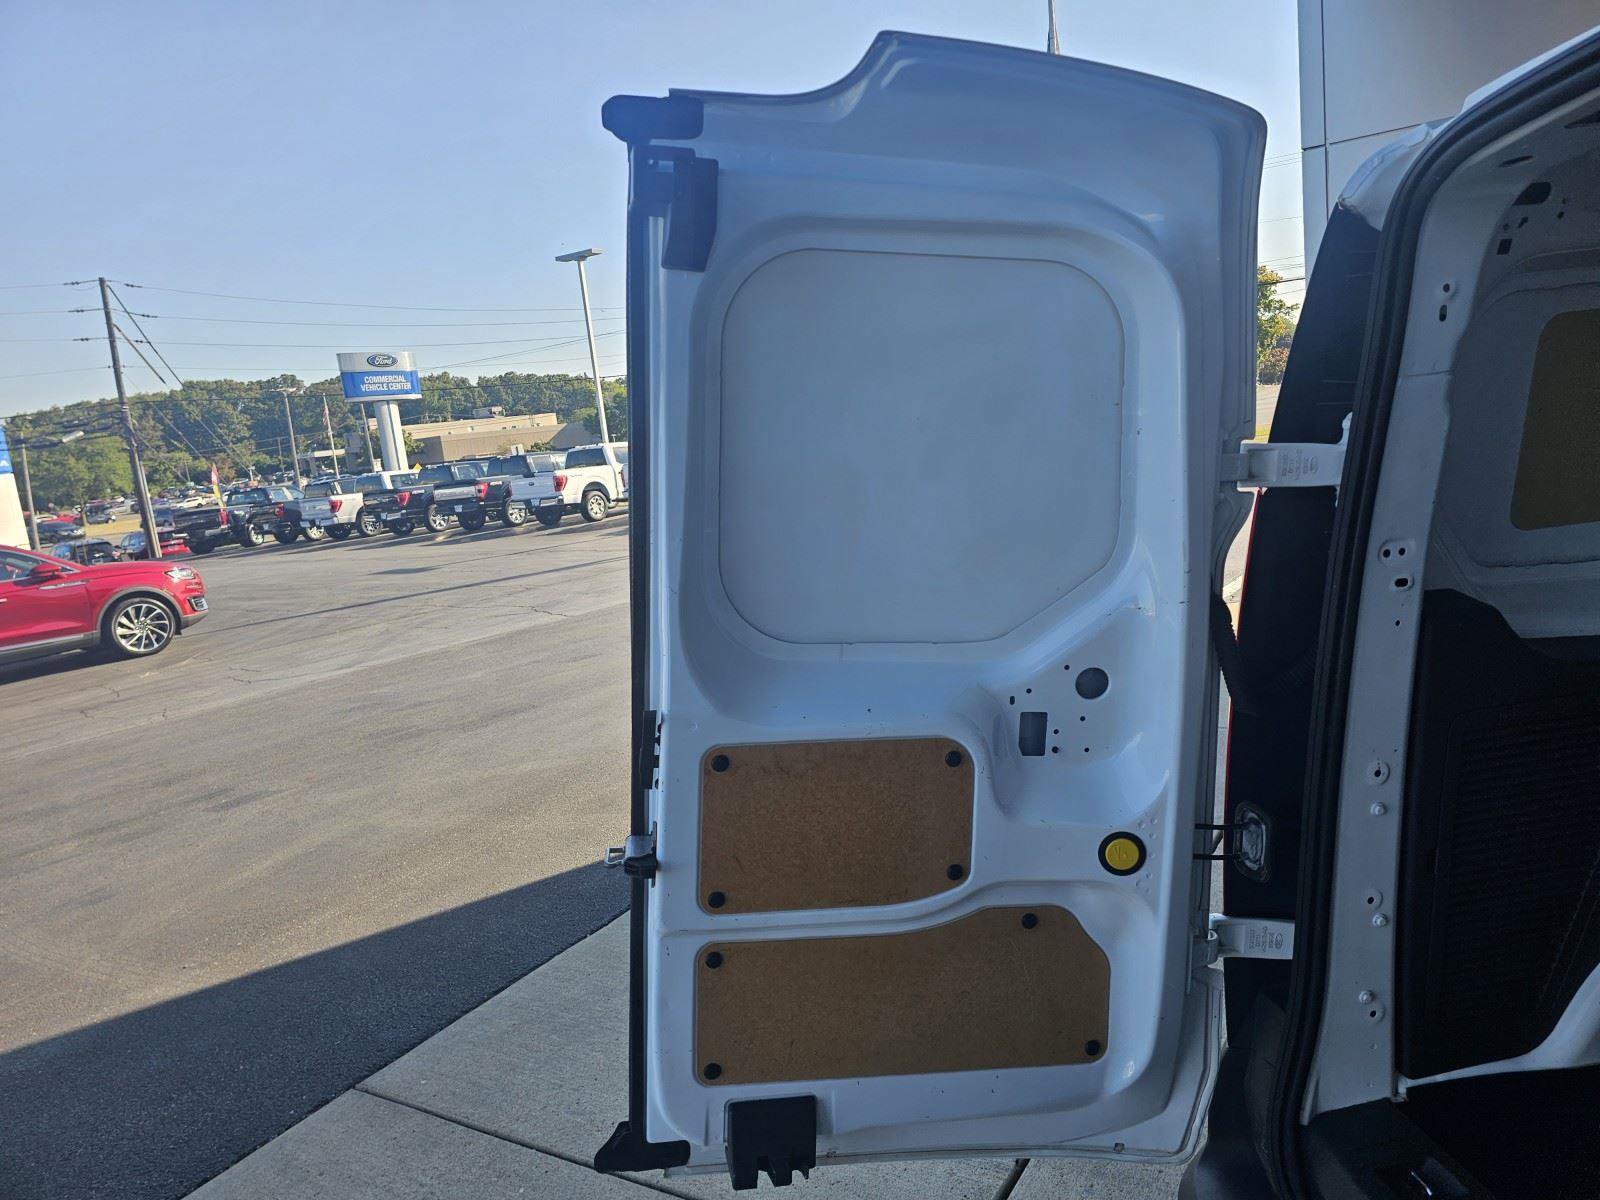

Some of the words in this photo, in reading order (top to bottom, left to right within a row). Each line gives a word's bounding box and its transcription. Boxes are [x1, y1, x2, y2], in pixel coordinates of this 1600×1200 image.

[374, 355, 393, 365] Ford
[364, 374, 406, 384] COMMERCIAL
[360, 383, 388, 392] VEHICLE
[388, 382, 412, 391] CENTER
